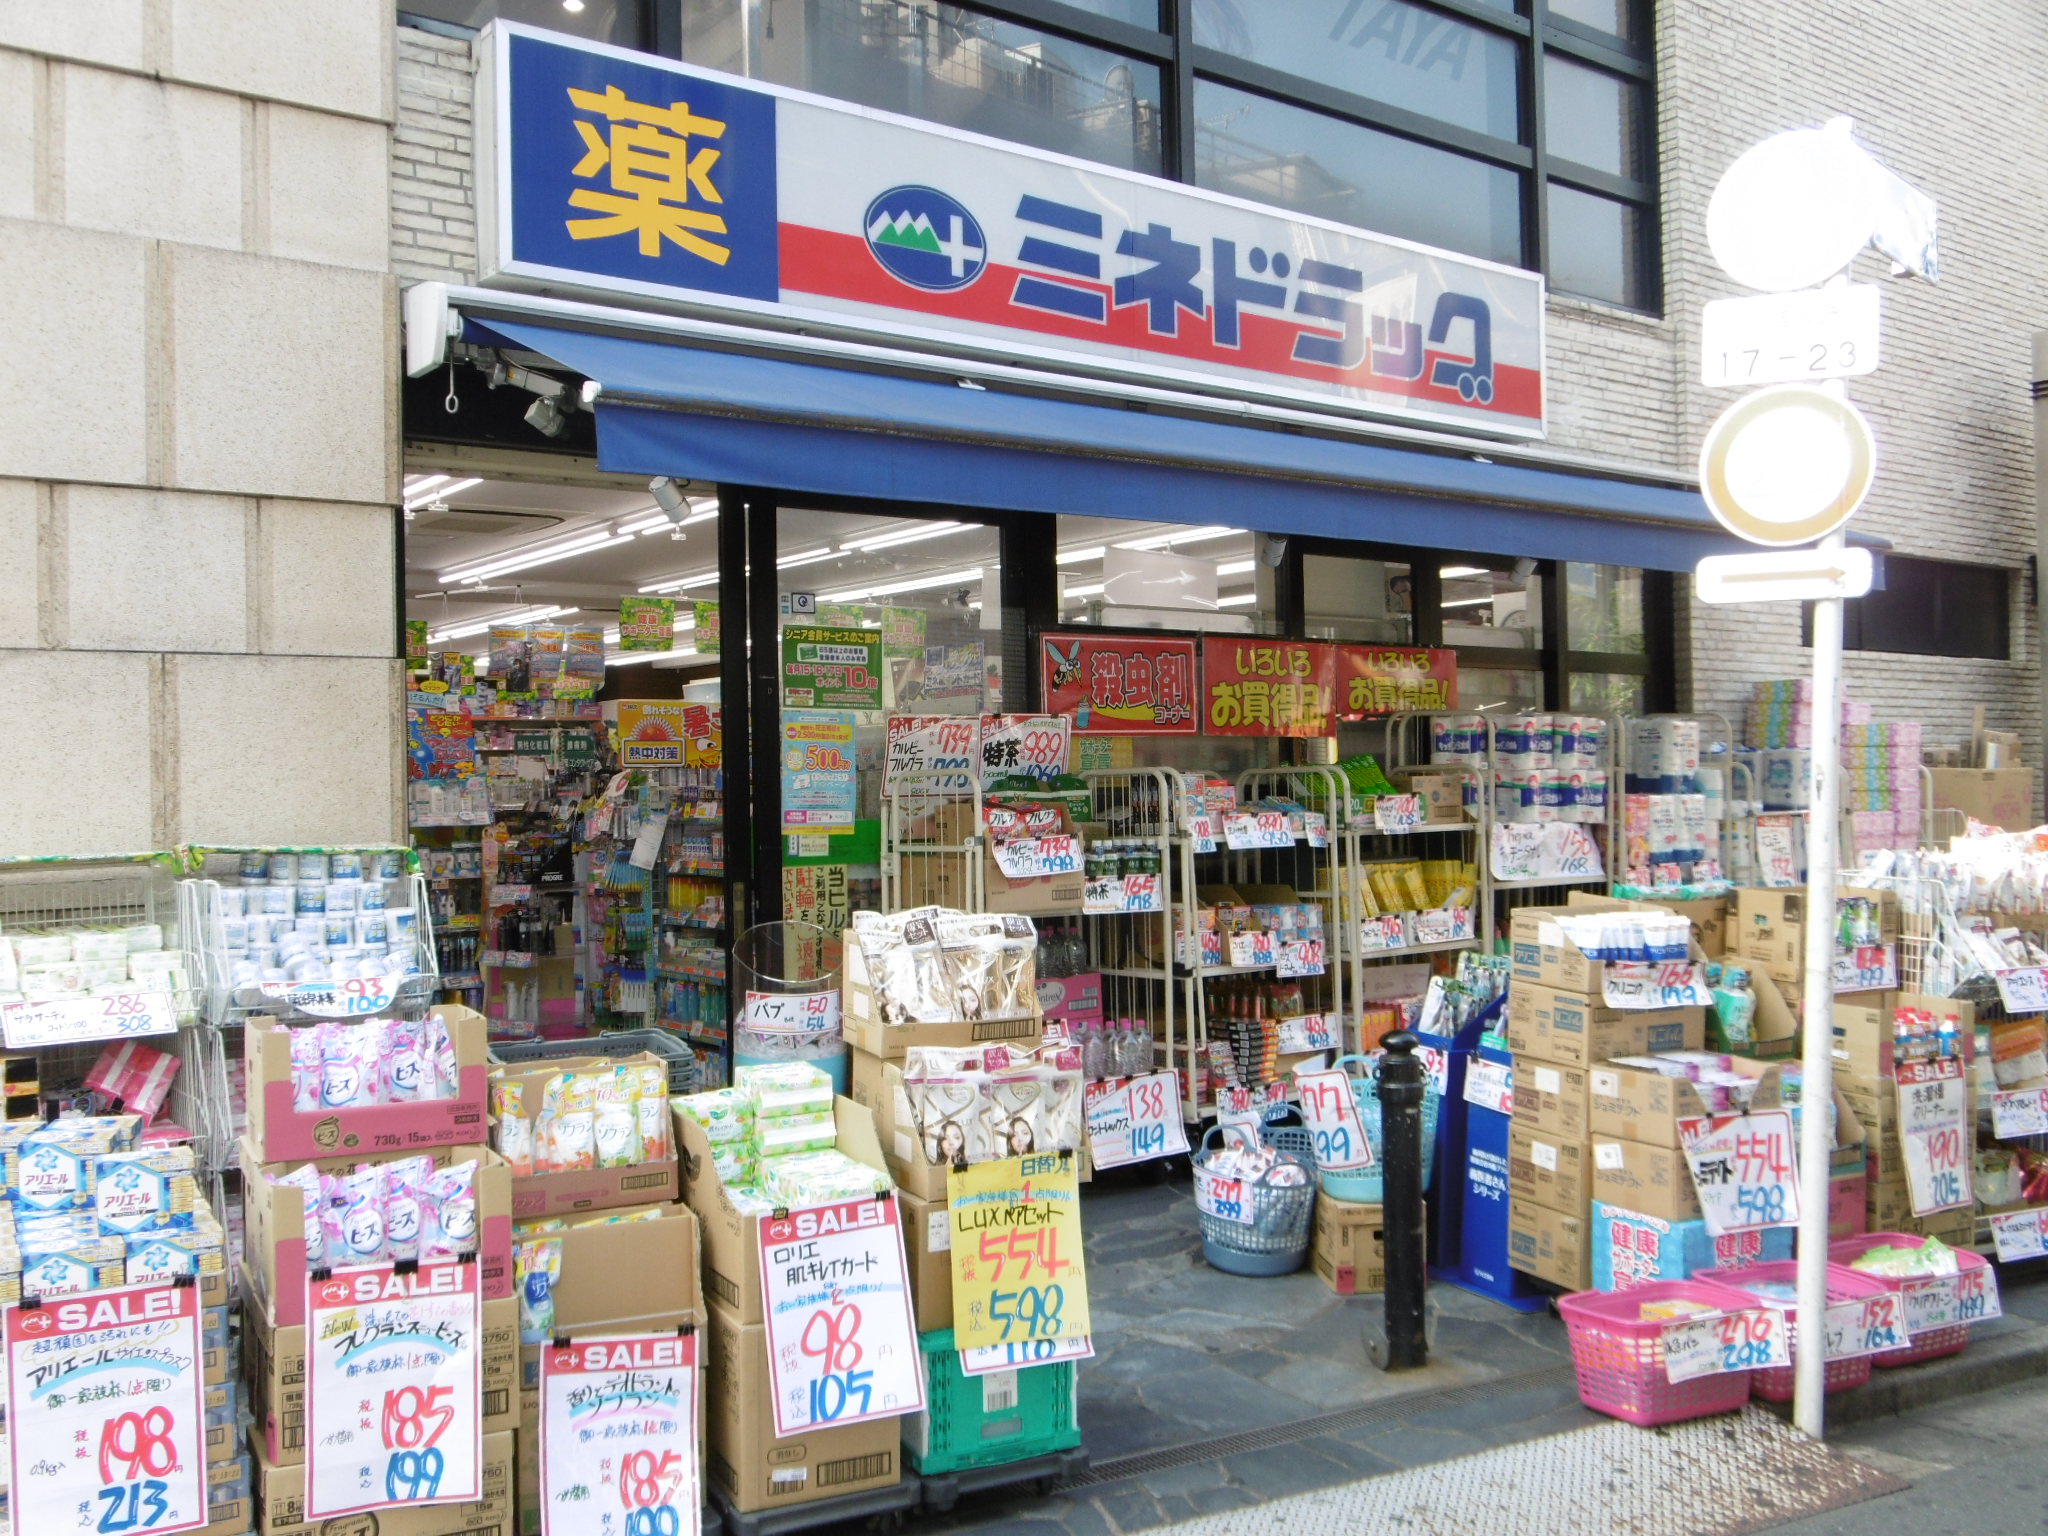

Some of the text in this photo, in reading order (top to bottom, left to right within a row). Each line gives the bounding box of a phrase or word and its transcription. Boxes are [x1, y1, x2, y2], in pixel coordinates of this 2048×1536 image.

[566, 84, 731, 266] 薬
[1009, 193, 1495, 405] ミネドラッグ
[1723, 341, 1856, 378] 17-23
[785, 628, 880, 644] シニア会員サービスのご案内
[1235, 647, 1312, 678] いろいろ
[1367, 651, 1432, 675] いろいろ
[1090, 651, 1187, 708] 殺虫剤
[1210, 680, 1331, 729] お買得品!
[1347, 675, 1449, 712] お買得品!
[1154, 706, 1190, 724] コーナー
[628, 746, 679, 760] 熱中対策
[892, 740, 924, 755] カルビー
[937, 723, 973, 756] 739
[983, 737, 1022, 768] 特茶
[1023, 730, 1063, 764] 989
[889, 757, 924, 772] フルグラ
[1006, 843, 1033, 856] カルビー
[1040, 836, 1071, 858] 739
[1003, 856, 1034, 869] フルグラ
[1042, 855, 1074, 872] 798
[1560, 856, 1589, 873] 168
[1085, 884, 1109, 901] 特茶
[1123, 876, 1157, 897] 165
[1125, 894, 1152, 911] 178
[345, 977, 383, 997] 93
[1657, 963, 1694, 987] 166
[102, 993, 146, 1016] 286
[347, 994, 390, 1013] 100
[806, 996, 828, 1015] 50
[1662, 985, 1698, 1005] 179
[14, 1011, 66, 1023] サラサーティ
[116, 1014, 152, 1033] 308
[754, 1003, 785, 1019] バブ
[806, 1016, 825, 1031] 54
[325, 1077, 353, 1096] ビーズ
[1129, 1081, 1164, 1122] 138
[374, 1133, 402, 1146] 730g
[598, 1126, 633, 1140] ソフラン
[1131, 1123, 1165, 1157] 149
[1736, 1132, 1790, 1183] 554
[1928, 1128, 1959, 1172] 190
[25, 1173, 69, 1185] アリエール
[1210, 1178, 1242, 1201] 277
[1931, 1172, 1960, 1206] 205
[103, 1193, 152, 1208] アリエール
[1214, 1199, 1242, 1218] 299
[1738, 1184, 1786, 1224] 598
[351, 1221, 380, 1246] ビーズ
[795, 1202, 886, 1238] SALE!
[773, 1241, 821, 1265] ロリエ
[1611, 1221, 1660, 1258] 健康
[1715, 1229, 1762, 1260] 健康
[786, 1250, 879, 1287] 肌キレイガード
[979, 1227, 1071, 1283] 554
[354, 1265, 464, 1302] SALE!
[58, 1288, 182, 1331] SALE!
[989, 1284, 1065, 1339] 598
[1861, 1299, 1894, 1328] 152
[800, 1302, 864, 1376] 98
[1720, 1314, 1773, 1344] 276
[1865, 1326, 1897, 1349] 164
[584, 1340, 683, 1371] SALE!
[1722, 1340, 1772, 1371] 298
[588, 1394, 660, 1420] ソフラン
[809, 1370, 874, 1425] 105
[381, 1384, 455, 1450] 185
[98, 1405, 178, 1486] 198
[385, 1447, 444, 1502] 199
[620, 1449, 683, 1509] 185
[97, 1479, 169, 1534] 213
